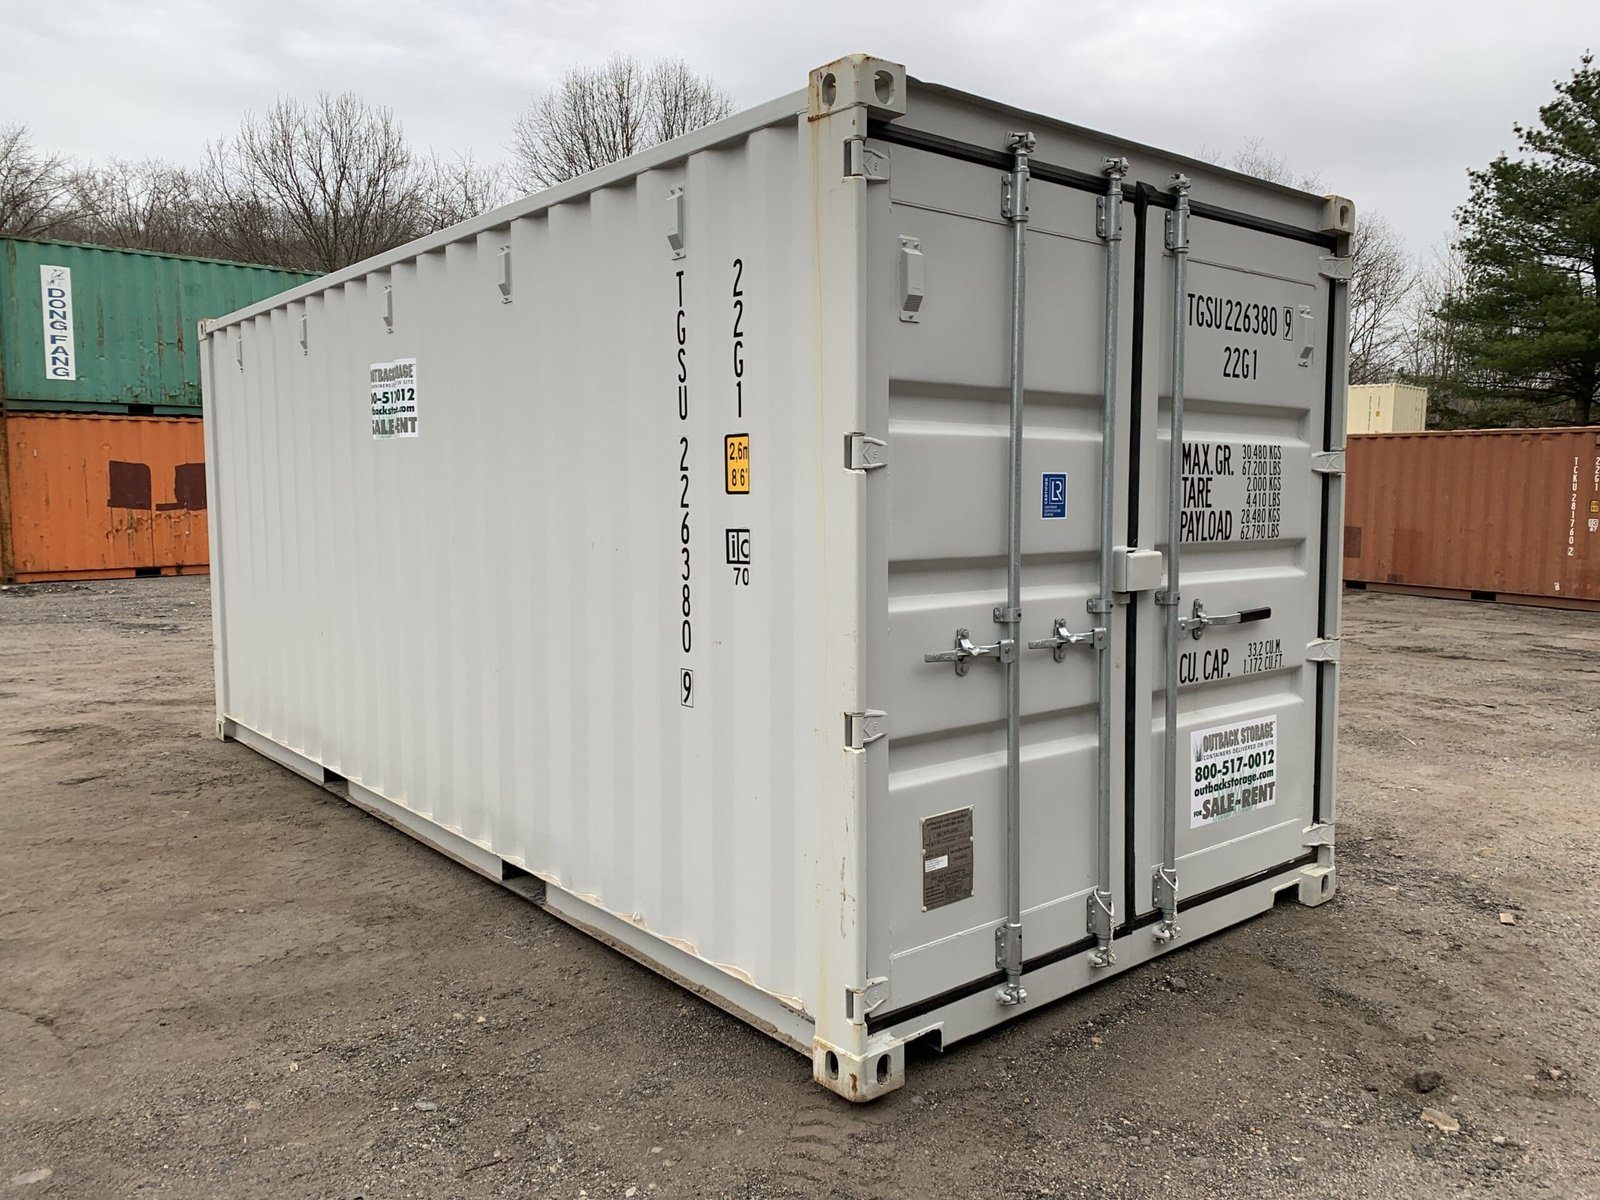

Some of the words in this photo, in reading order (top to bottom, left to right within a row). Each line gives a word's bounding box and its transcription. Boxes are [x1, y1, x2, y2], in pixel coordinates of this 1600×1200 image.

[47, 288, 68, 331] DONG
[676, 270, 688, 421] TGSU
[732, 258, 744, 418] 22G1
[50, 335, 70, 377] FANG
[1223, 346, 1257, 380] 22G1
[1241, 460, 1267, 476] 67.200
[1269, 461, 1281, 476] LBS
[1242, 444, 1267, 460] 30.480
[1268, 445, 1281, 460] KGS
[1571, 457, 1579, 491] TCKU
[1182, 477, 1213, 508] TARE
[1246, 476, 1267, 492] 2.000
[1268, 477, 1281, 492] KGS
[1246, 492, 1266, 508] 4.410
[1268, 492, 1280, 507] LBS
[1180, 510, 1232, 542] PAYLOAD
[1240, 508, 1266, 524] 28.480
[1268, 508, 1280, 523] KGS
[1240, 524, 1265, 540] 62.790
[1267, 523, 1279, 538] LBS
[1568, 493, 1577, 545] 281760
[679, 436, 691, 653] 226380
[733, 567, 750, 586] 70
[1180, 652, 1199, 684] CU.
[1203, 648, 1231, 680] CAP.
[1248, 641, 1264, 657] 33.2
[682, 669, 692, 705] 9
[1203, 728, 1240, 753] OUTBACK
[1240, 721, 1274, 745] STORAGE
[1203, 749, 1232, 761] CONTAINERS
[1232, 744, 1256, 755] DELIVERED
[1194, 769, 1274, 797] outbackstorage.com
[1195, 749, 1275, 783] 800-517-0012
[1193, 809, 1202, 818] FOR
[1202, 792, 1235, 820] SALE
[1241, 781, 1276, 808] RENT
